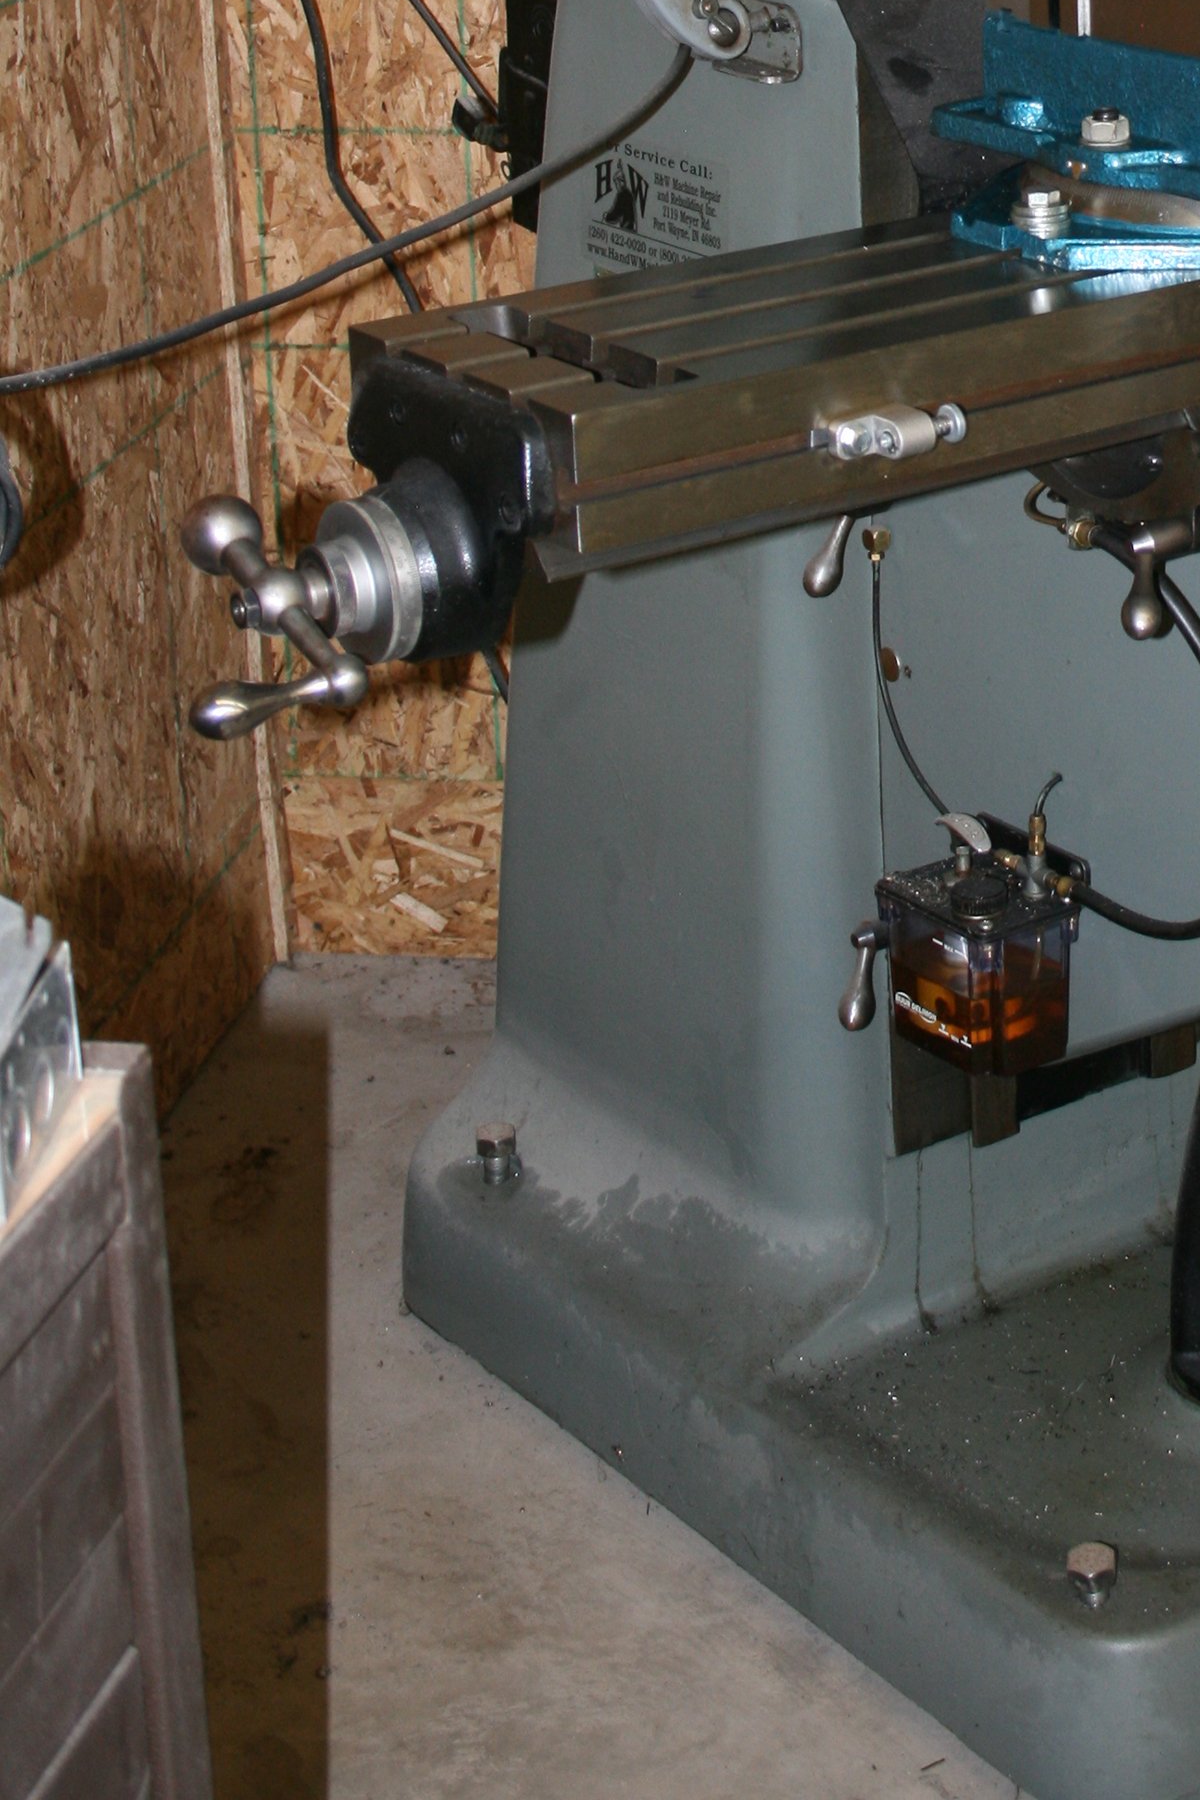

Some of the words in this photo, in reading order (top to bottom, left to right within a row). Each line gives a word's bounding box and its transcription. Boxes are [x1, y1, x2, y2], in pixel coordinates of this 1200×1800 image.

[624, 143, 675, 169] Service
[679, 159, 713, 180] Call:
[648, 247, 658, 258] or
